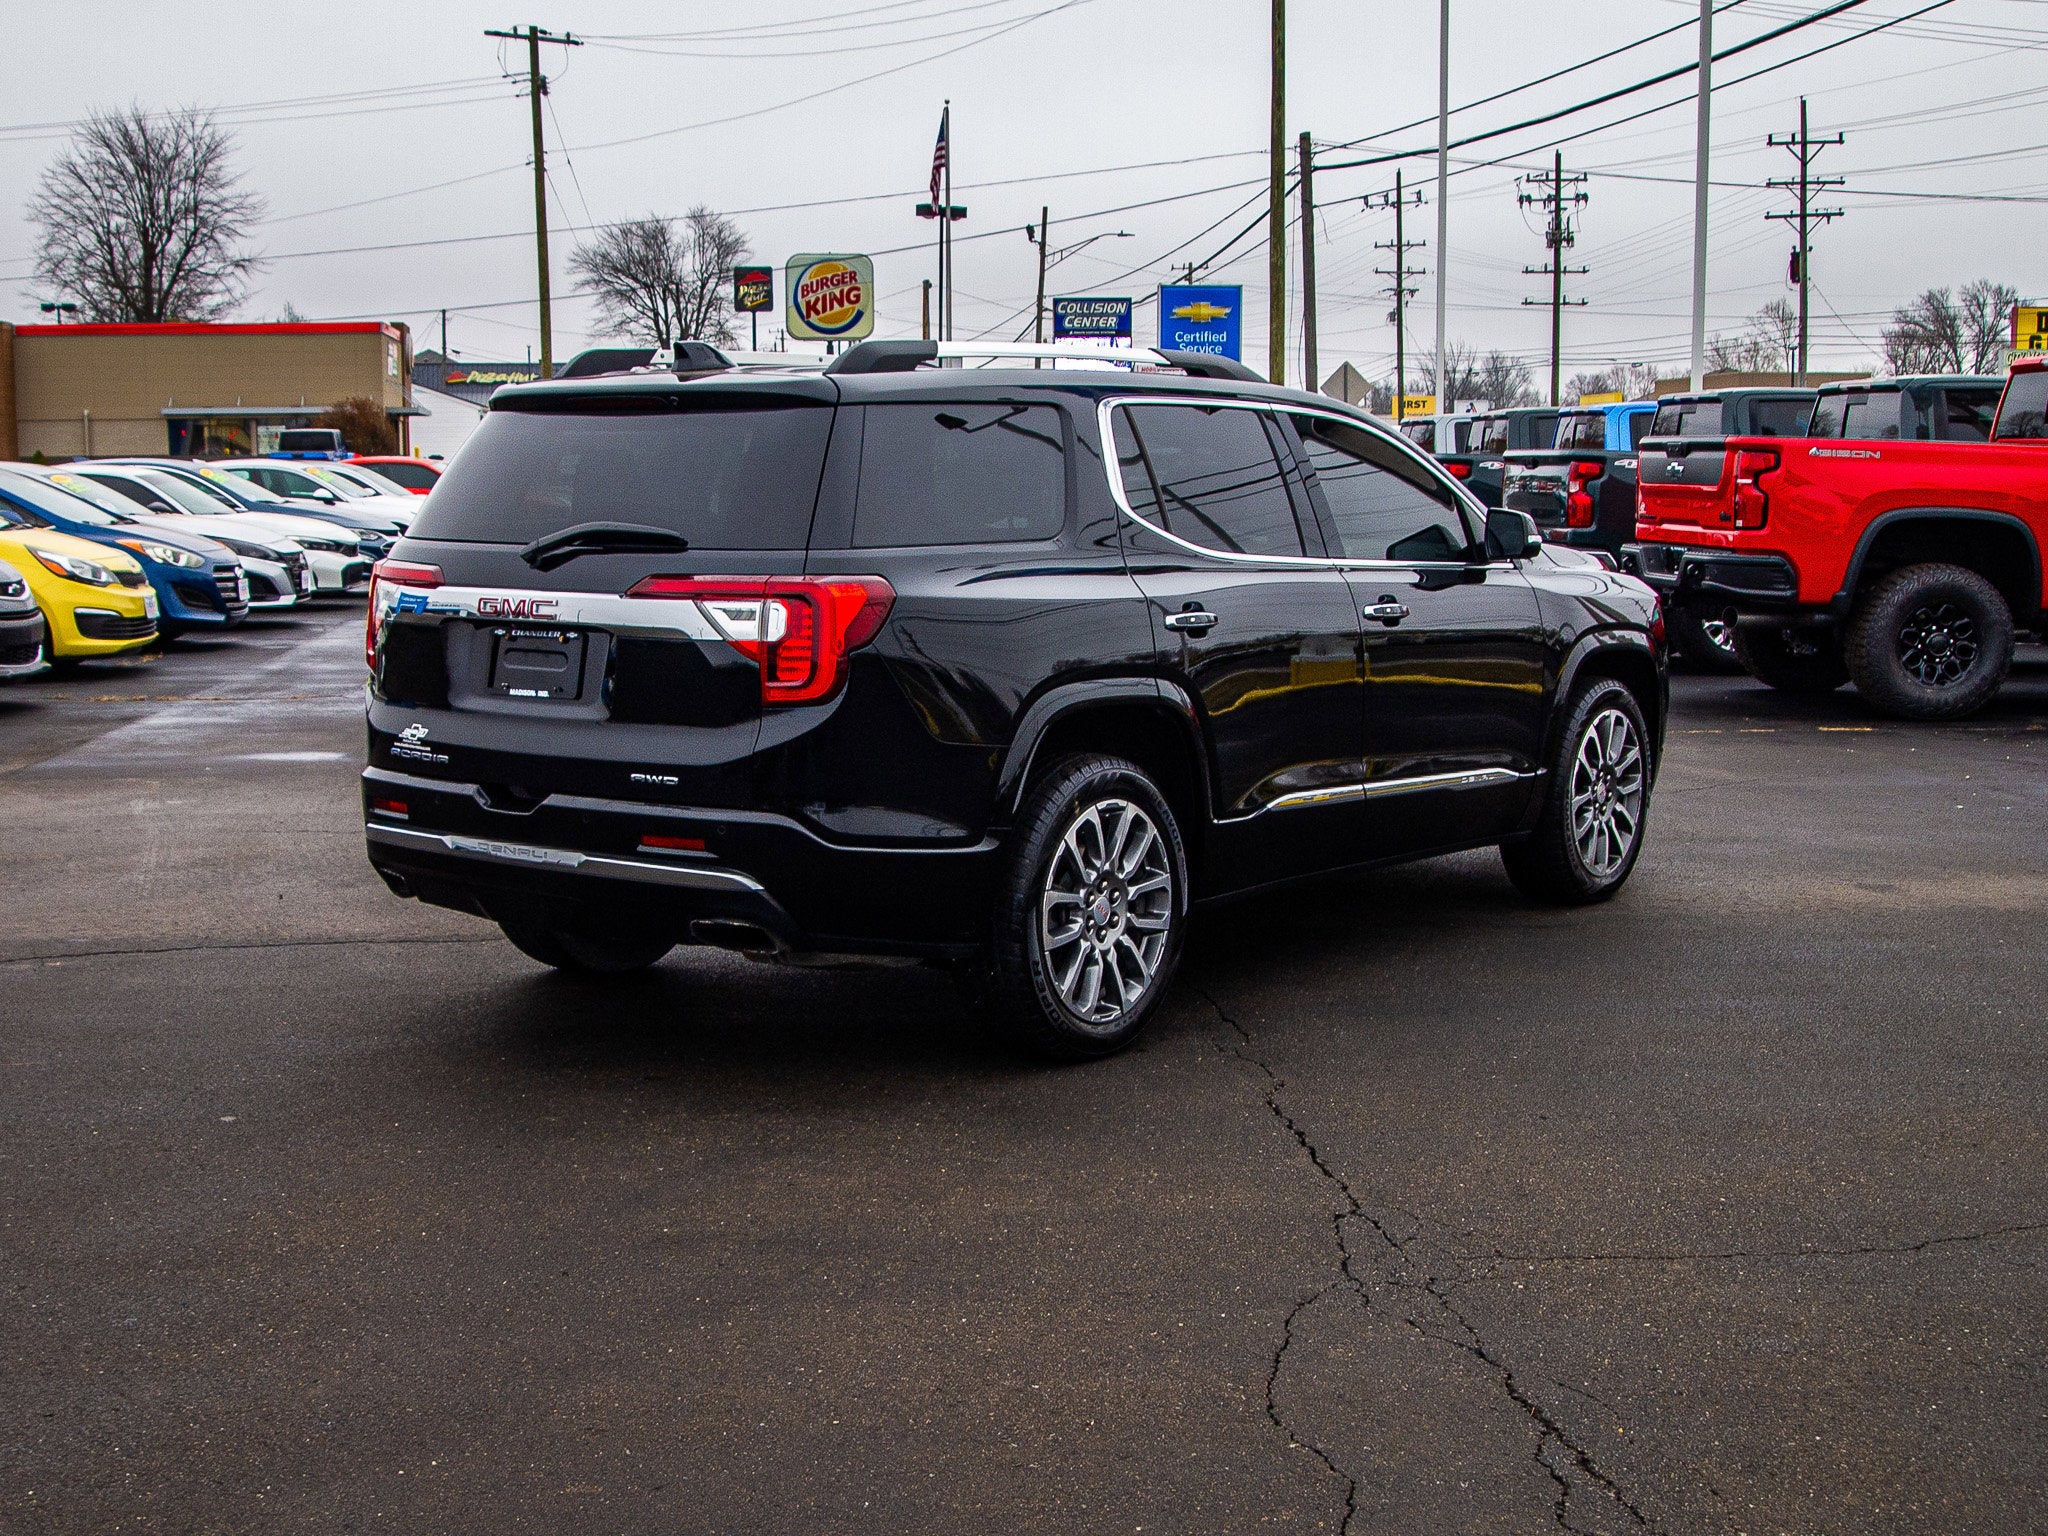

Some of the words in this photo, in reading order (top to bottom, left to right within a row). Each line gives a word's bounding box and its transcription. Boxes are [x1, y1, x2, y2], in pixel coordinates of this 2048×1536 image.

[801, 270, 858, 299] BURGER
[805, 286, 862, 320] KING
[1057, 301, 1127, 314] COLLISION
[1064, 315, 1118, 329] CENTER
[1175, 331, 1227, 343] Certified
[1179, 343, 1223, 354] Service
[477, 597, 560, 621] GMC
[511, 629, 561, 638] CHANDLER
[390, 747, 449, 765] ACADIA
[630, 773, 679, 785] AWD
[477, 842, 548, 859] DENALI
